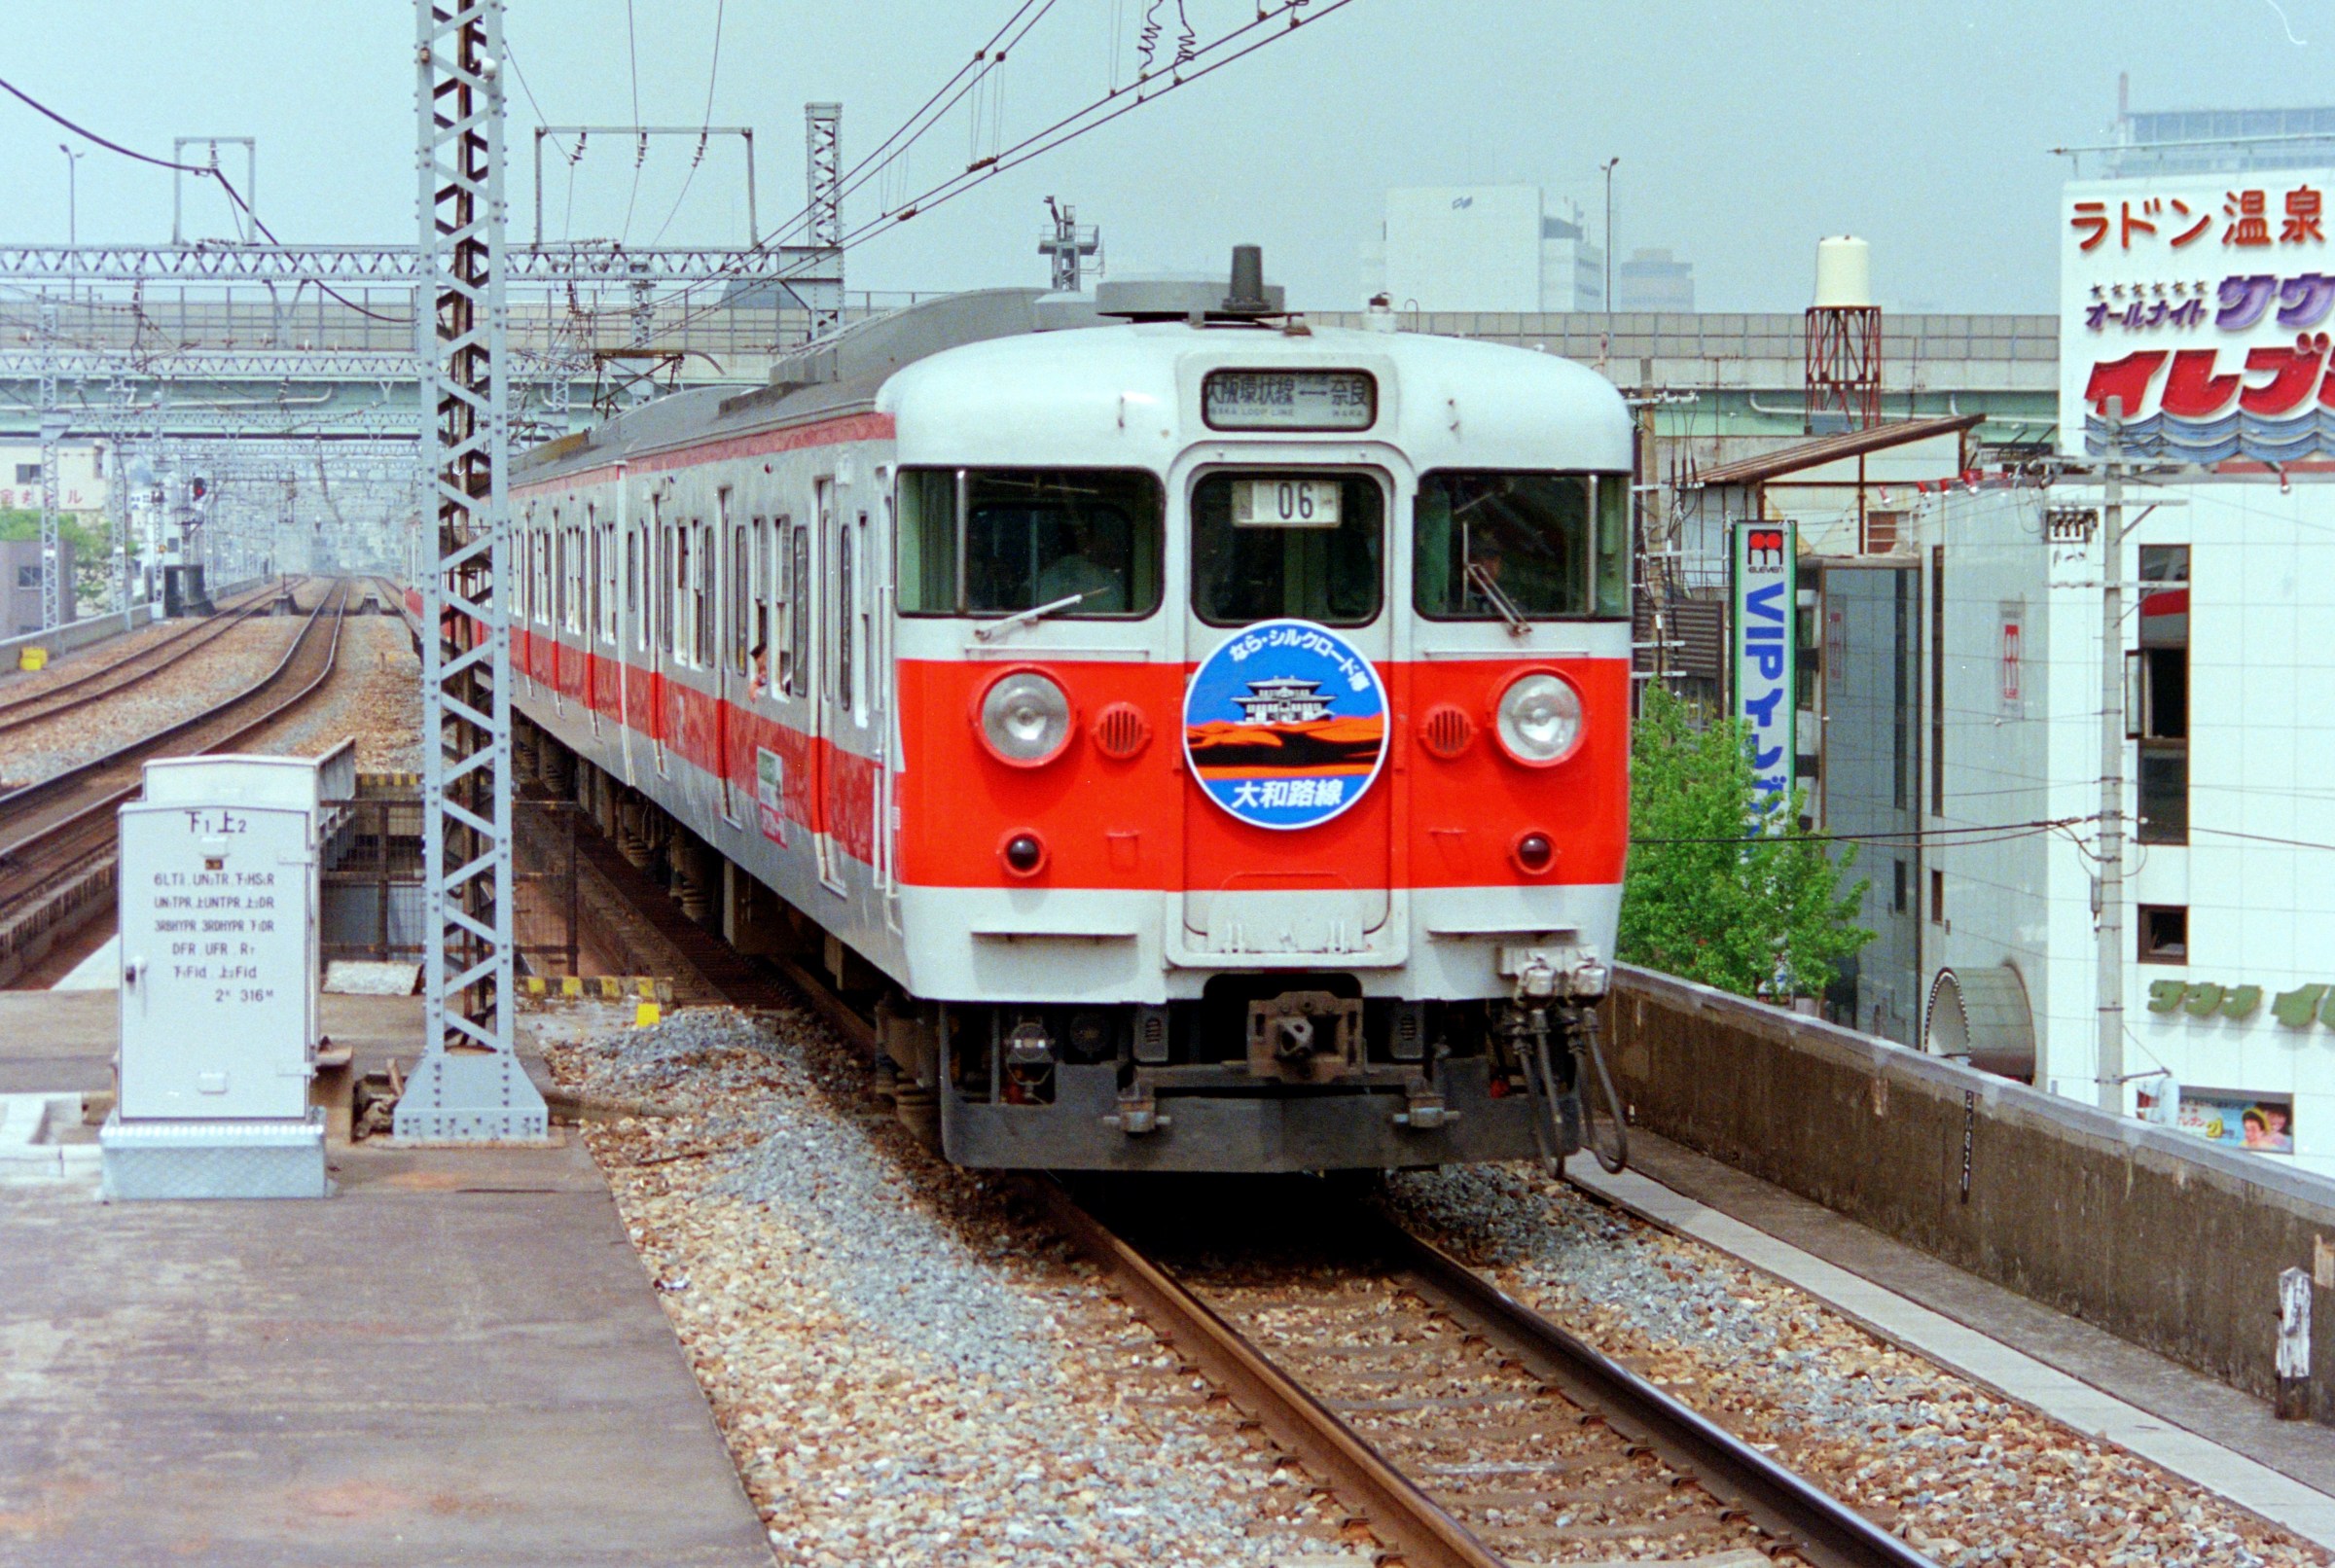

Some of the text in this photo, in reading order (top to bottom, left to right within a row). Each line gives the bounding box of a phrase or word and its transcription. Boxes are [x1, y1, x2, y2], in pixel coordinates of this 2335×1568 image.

[2070, 185, 2326, 251] ラドン温泉
[2085, 299, 2209, 331] オールナイト
[1330, 377, 1367, 407] 奈良
[2084, 332, 2335, 418] イレブ
[1277, 481, 1313, 519] 06
[1231, 779, 1345, 809] 大和路線
[172, 942, 196, 955] DFR
[205, 942, 229, 955] UFR
[2271, 982, 2335, 1031] イ
